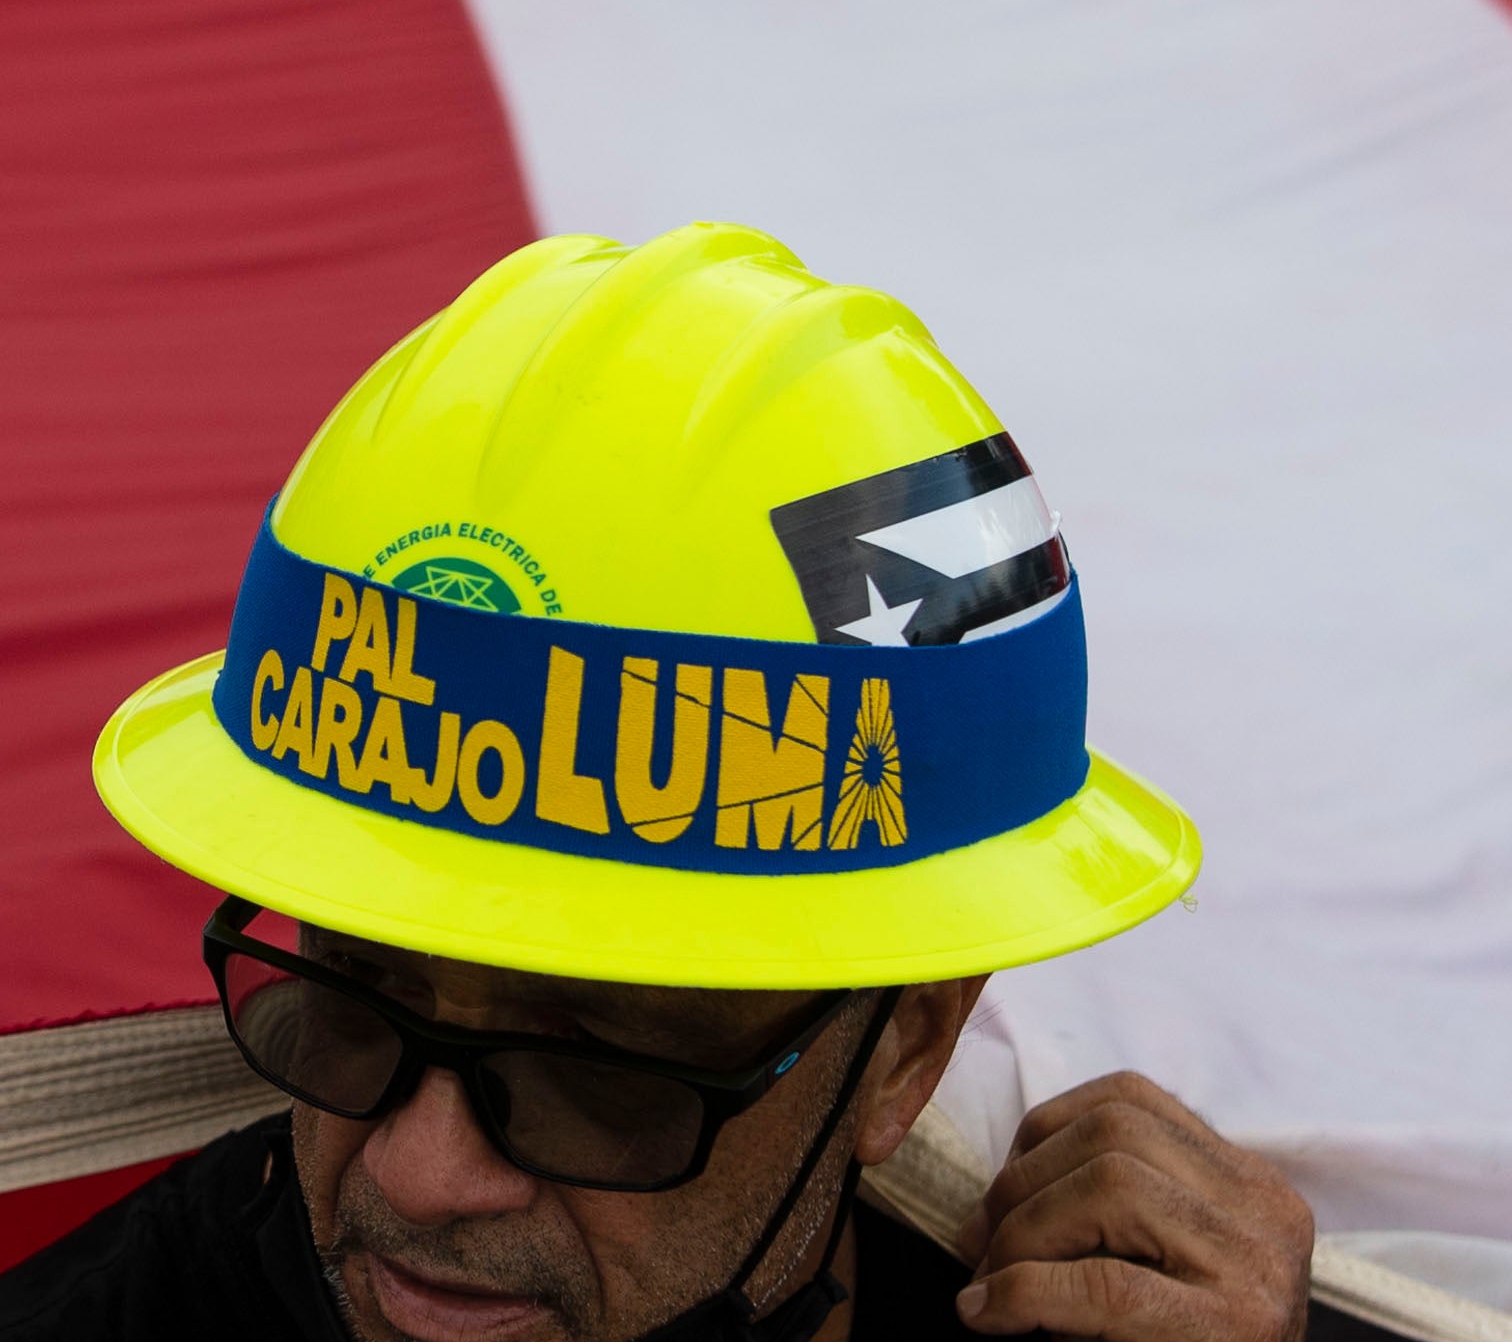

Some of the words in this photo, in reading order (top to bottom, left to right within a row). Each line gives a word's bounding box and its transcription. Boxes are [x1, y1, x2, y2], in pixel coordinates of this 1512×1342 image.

[362, 563, 377, 581] E
[375, 522, 453, 567] ENERGIA
[457, 522, 547, 587] ELECTRICA
[539, 589, 563, 616] DE
[311, 572, 436, 706] PAL
[251, 648, 525, 826] CARAJO
[535, 645, 909, 851] LUMA
